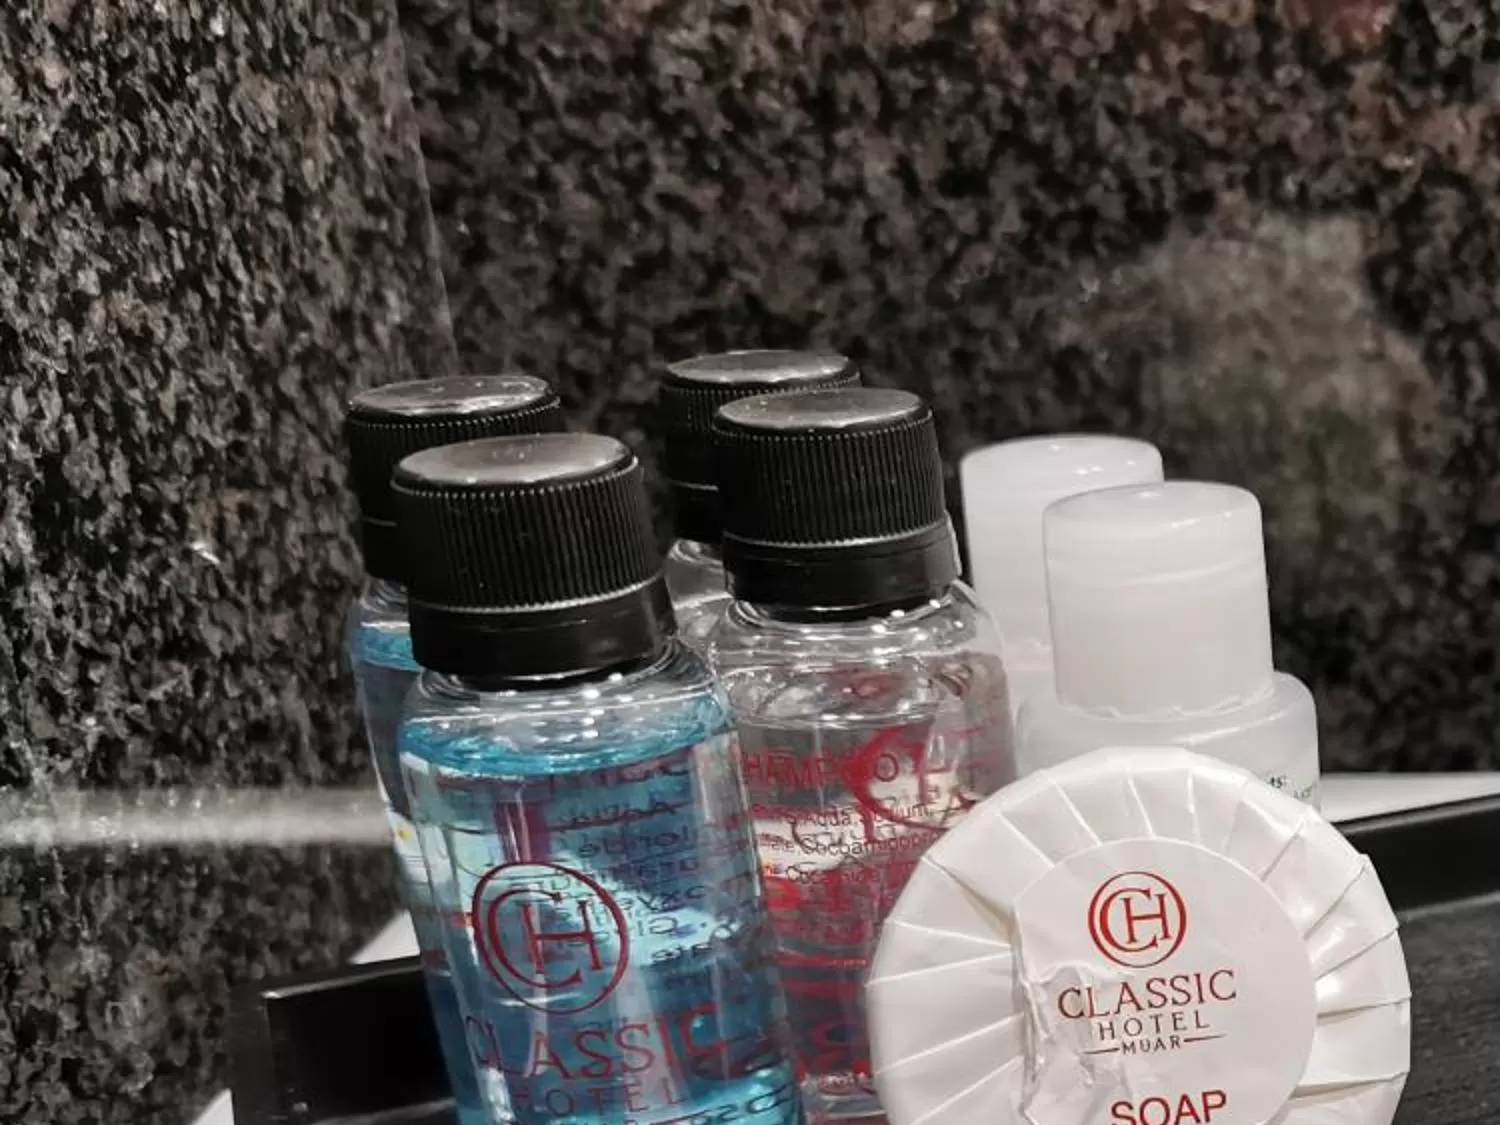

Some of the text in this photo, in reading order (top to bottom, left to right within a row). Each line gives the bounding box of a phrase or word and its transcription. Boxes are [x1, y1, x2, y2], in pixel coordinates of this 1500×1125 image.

[1057, 969, 1237, 1019] CLASSIC
[1098, 1009, 1211, 1041] HOTEL
[1122, 1034, 1182, 1056] MUAR
